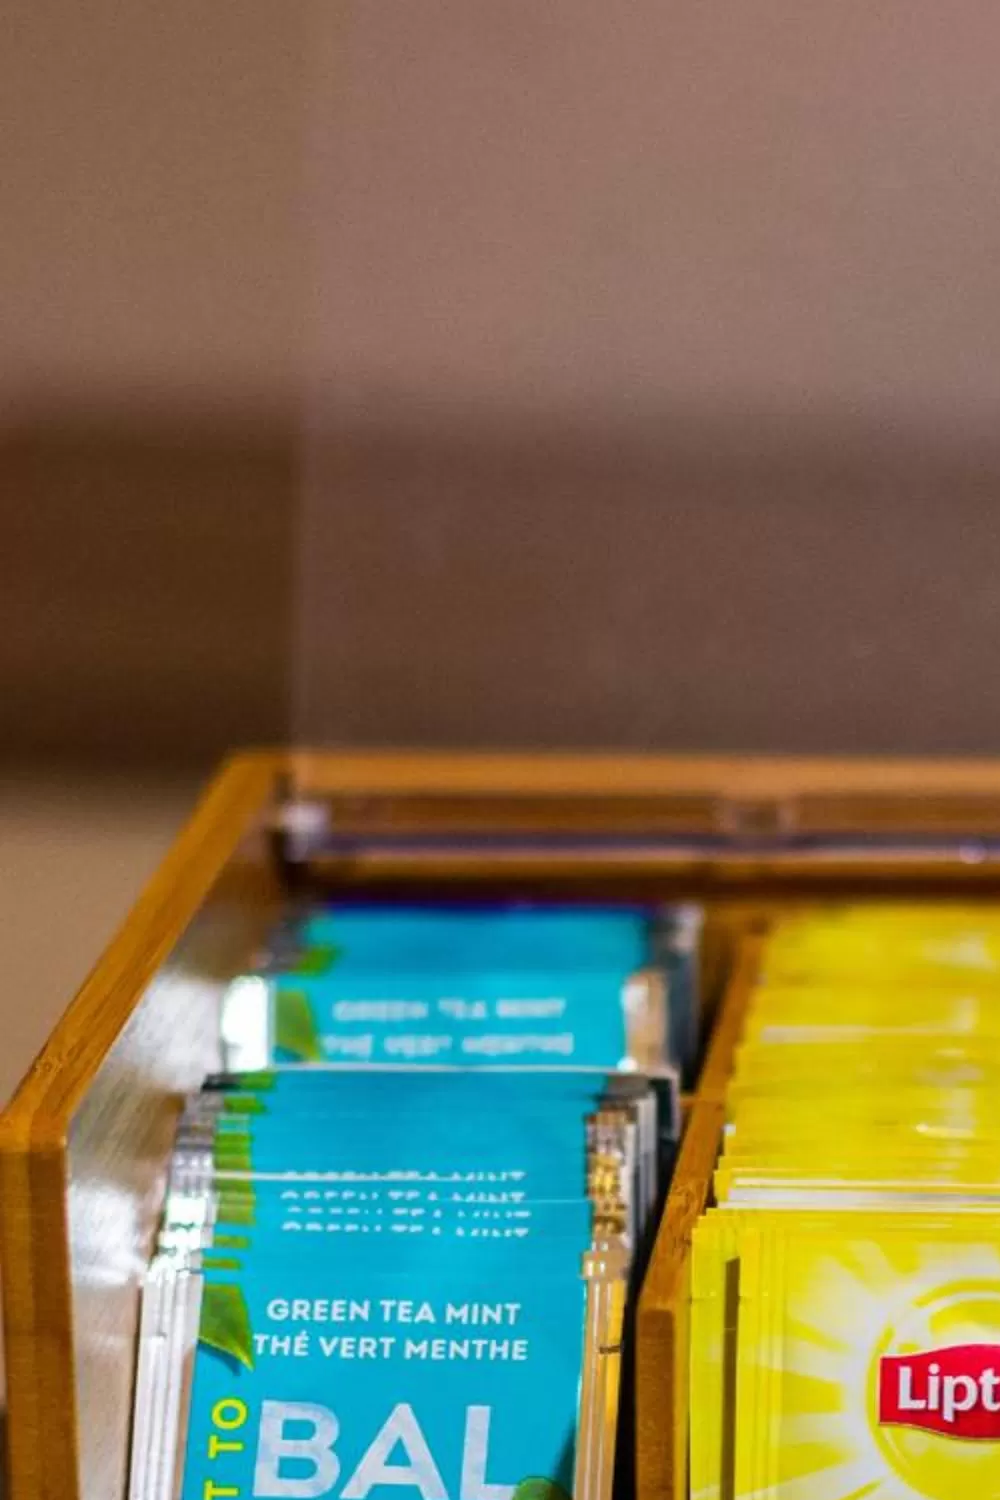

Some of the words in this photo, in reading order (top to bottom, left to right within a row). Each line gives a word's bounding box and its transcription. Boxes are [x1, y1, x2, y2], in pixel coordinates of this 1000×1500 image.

[266, 1299, 370, 1322] GREEN
[380, 1300, 436, 1324] TEA
[444, 1302, 522, 1326] MINT
[253, 1332, 310, 1356] THÉ
[318, 1336, 396, 1359] VERT
[403, 1339, 529, 1361] MENTHE
[207, 1397, 249, 1460] TO
